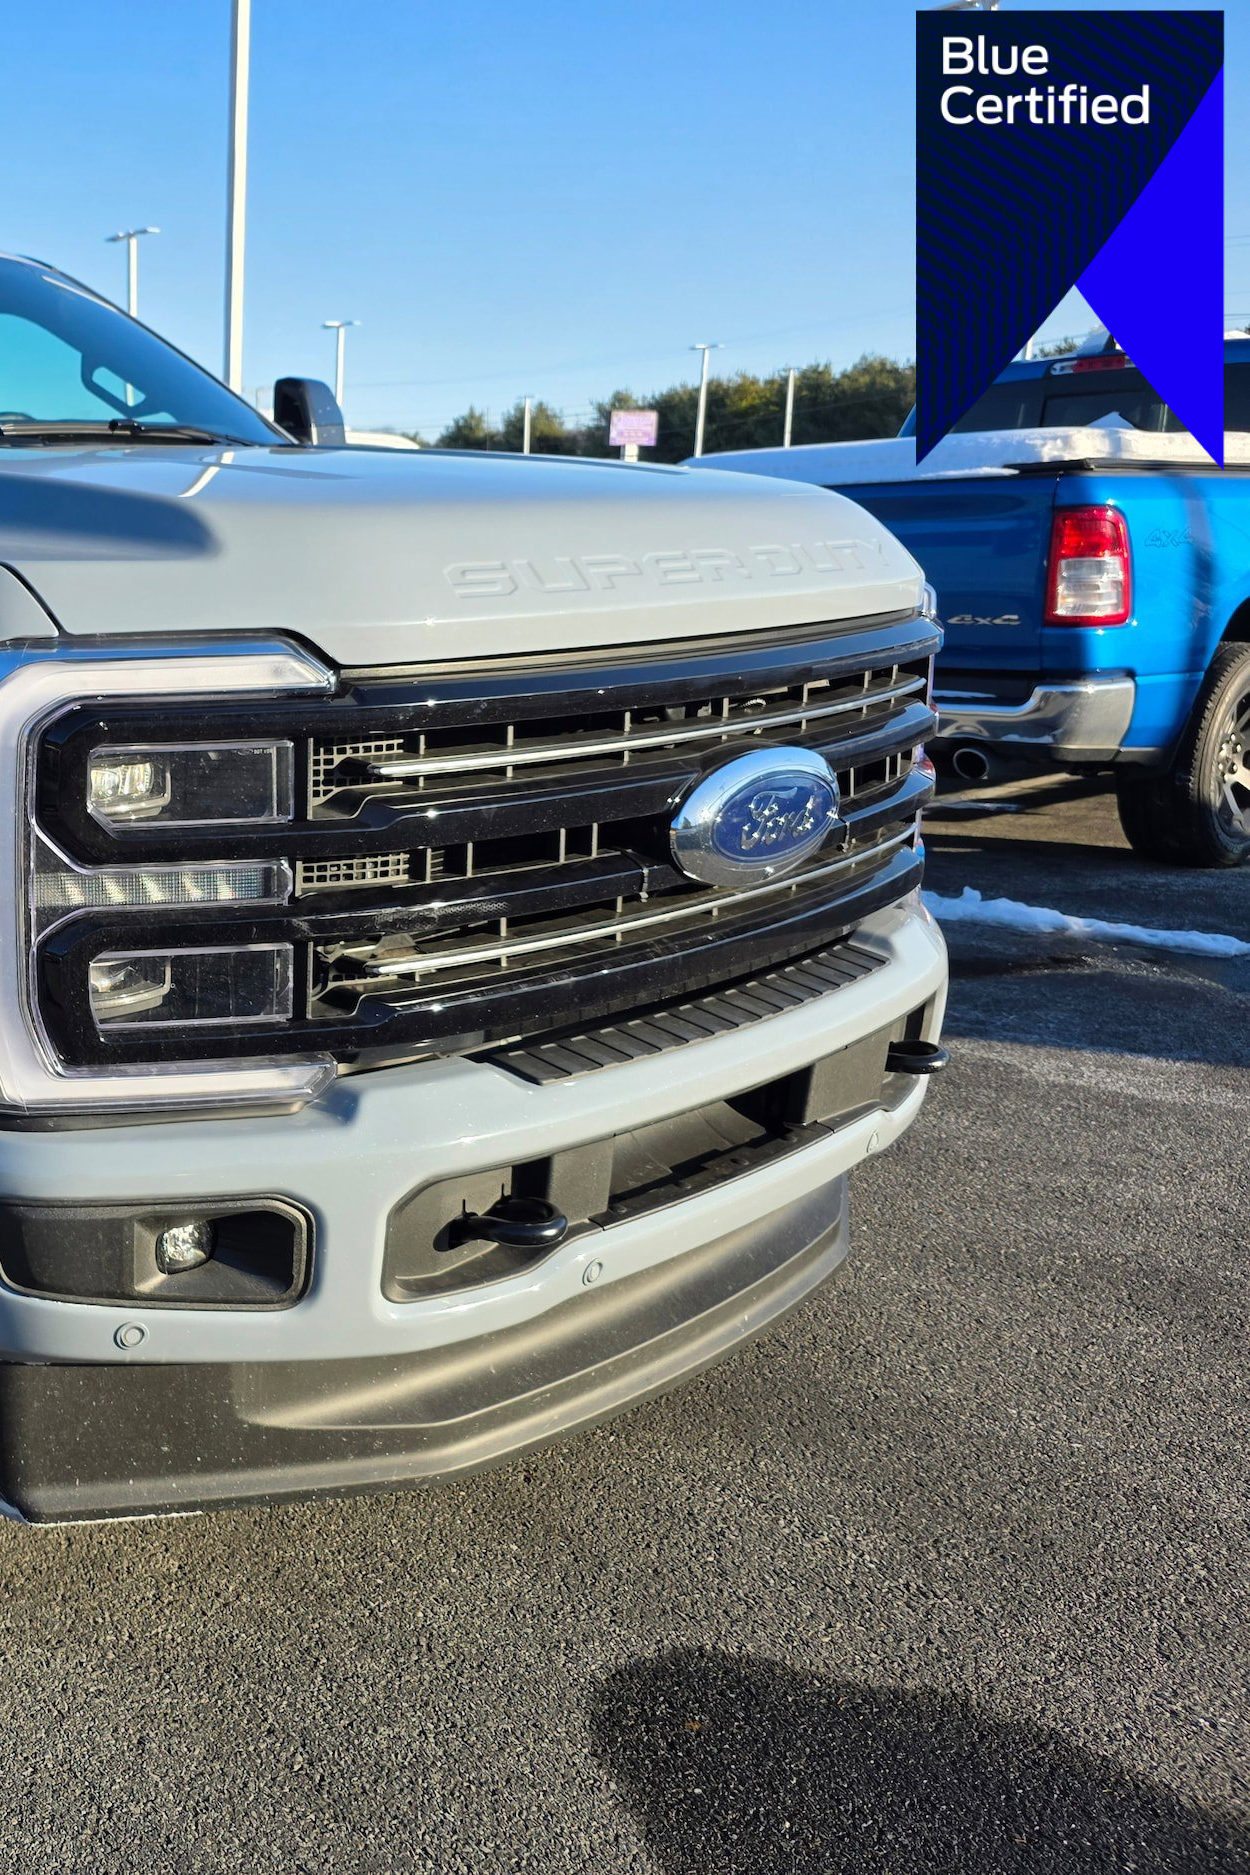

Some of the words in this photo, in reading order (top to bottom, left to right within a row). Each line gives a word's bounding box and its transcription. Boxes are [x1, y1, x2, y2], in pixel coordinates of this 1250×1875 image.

[442, 547, 753, 599] SUPER
[748, 537, 891, 577] DUTY
[740, 787, 815, 851] Ford
